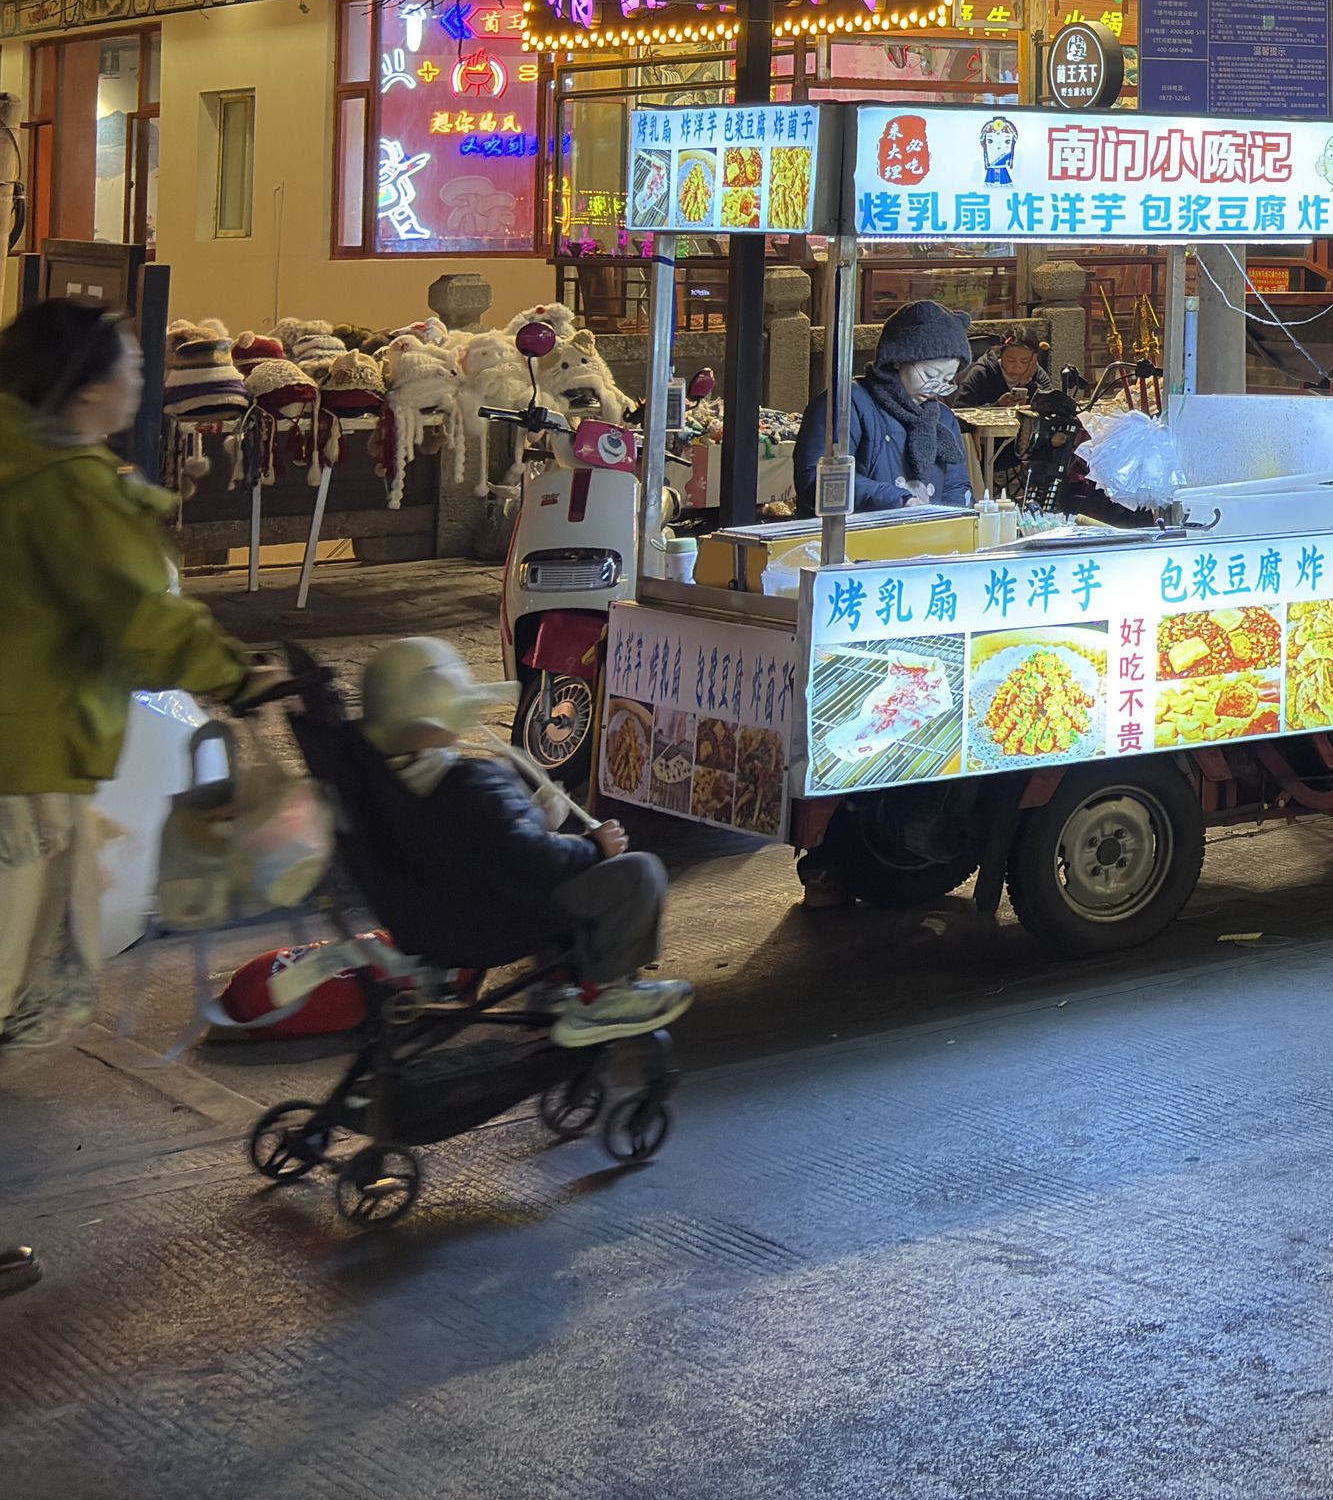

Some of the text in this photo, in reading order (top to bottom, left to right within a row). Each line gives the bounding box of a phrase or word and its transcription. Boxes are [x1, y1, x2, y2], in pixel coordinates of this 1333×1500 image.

[430, 111, 523, 135] 想你的风
[636, 110, 813, 143] 烤乳扇 炸洋芋 包浆豆腐 炸菌子
[883, 121, 903, 180] 来大理
[904, 137, 925, 176] 必吃
[1048, 124, 1292, 184] 南门小陈记
[859, 190, 991, 232] 烤乳扇
[1007, 192, 1126, 232] 炸洋芋
[1139, 193, 1286, 232] 包浆豆腐
[827, 573, 958, 632] 烤乳扇
[984, 563, 1103, 614] 炸洋芋
[1160, 547, 1283, 603] 包浆豆腐
[1115, 617, 1147, 754] 好吃不贵
